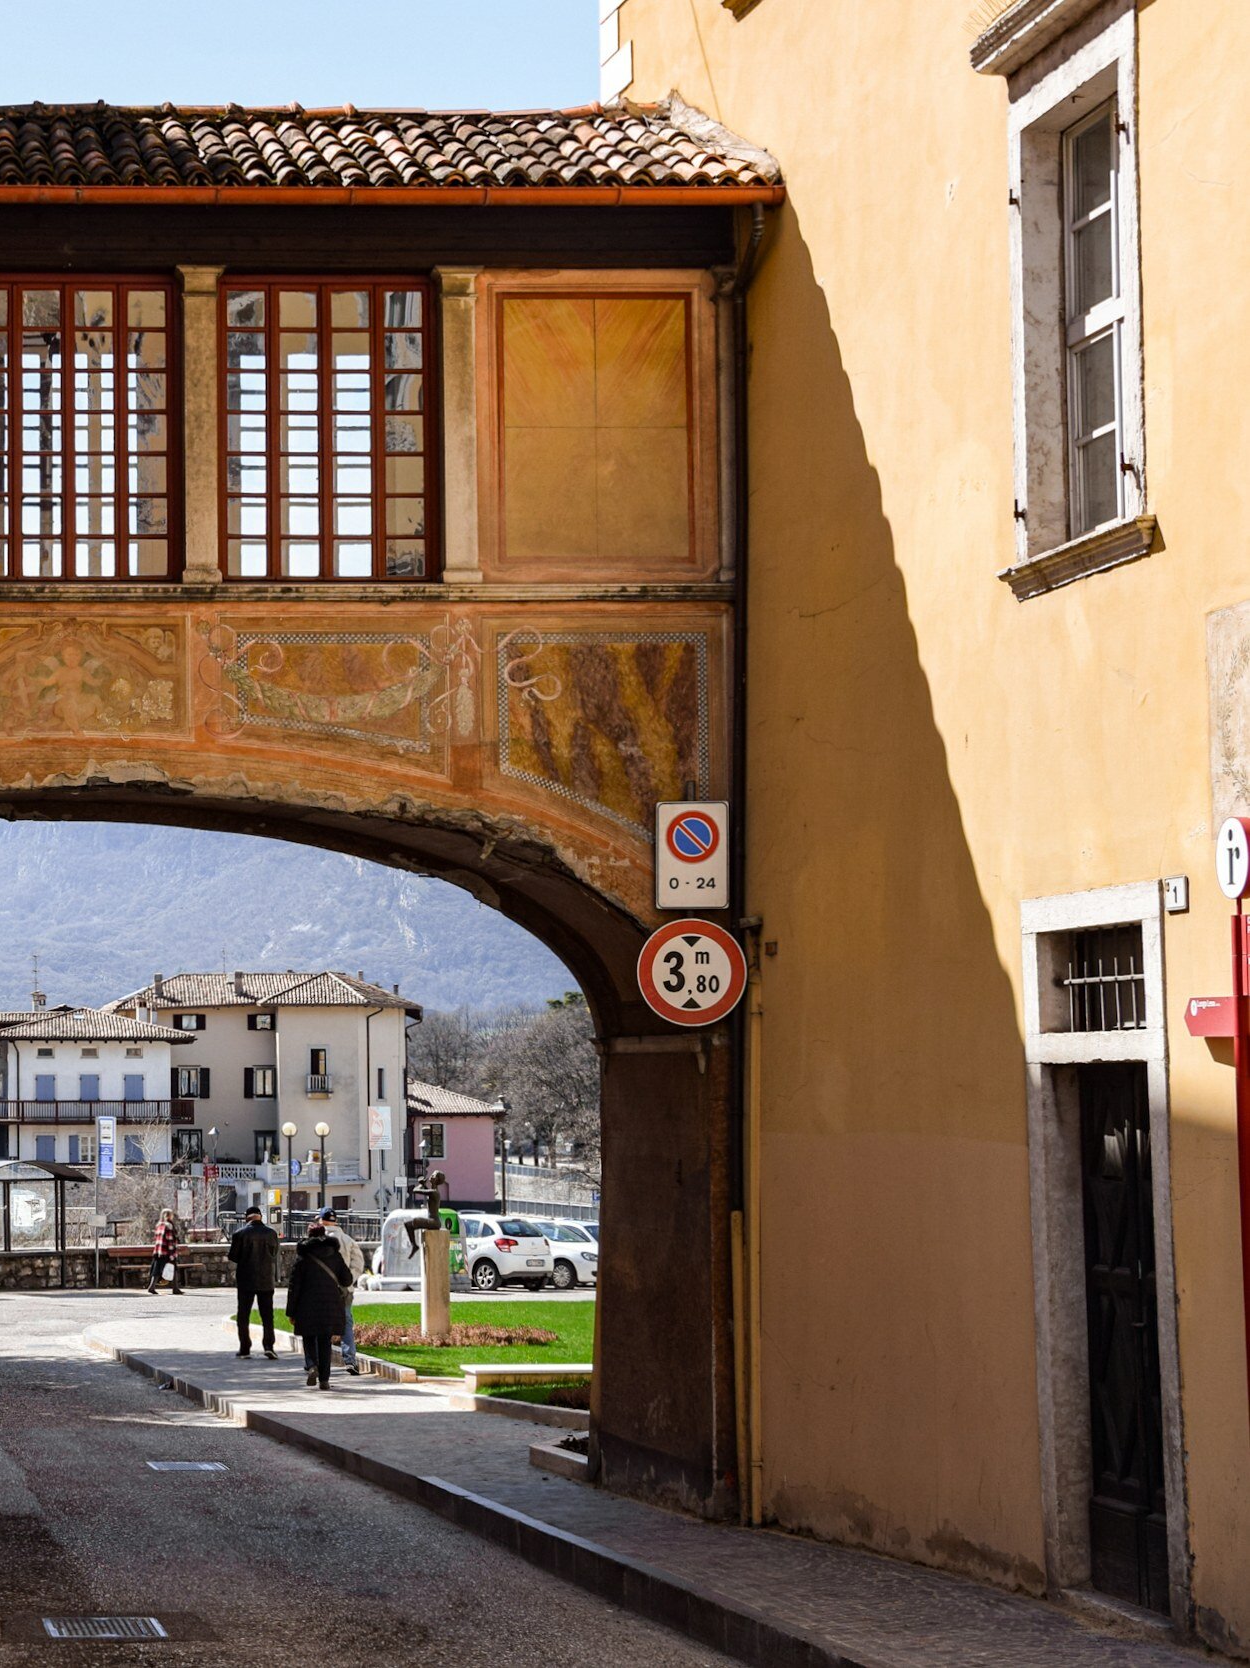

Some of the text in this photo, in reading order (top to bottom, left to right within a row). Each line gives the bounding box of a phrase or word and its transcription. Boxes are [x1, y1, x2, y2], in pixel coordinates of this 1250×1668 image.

[669, 877, 679, 889] 0
[696, 877, 716, 889] 24
[1172, 886, 1178, 903] 1
[695, 951, 710, 965] m
